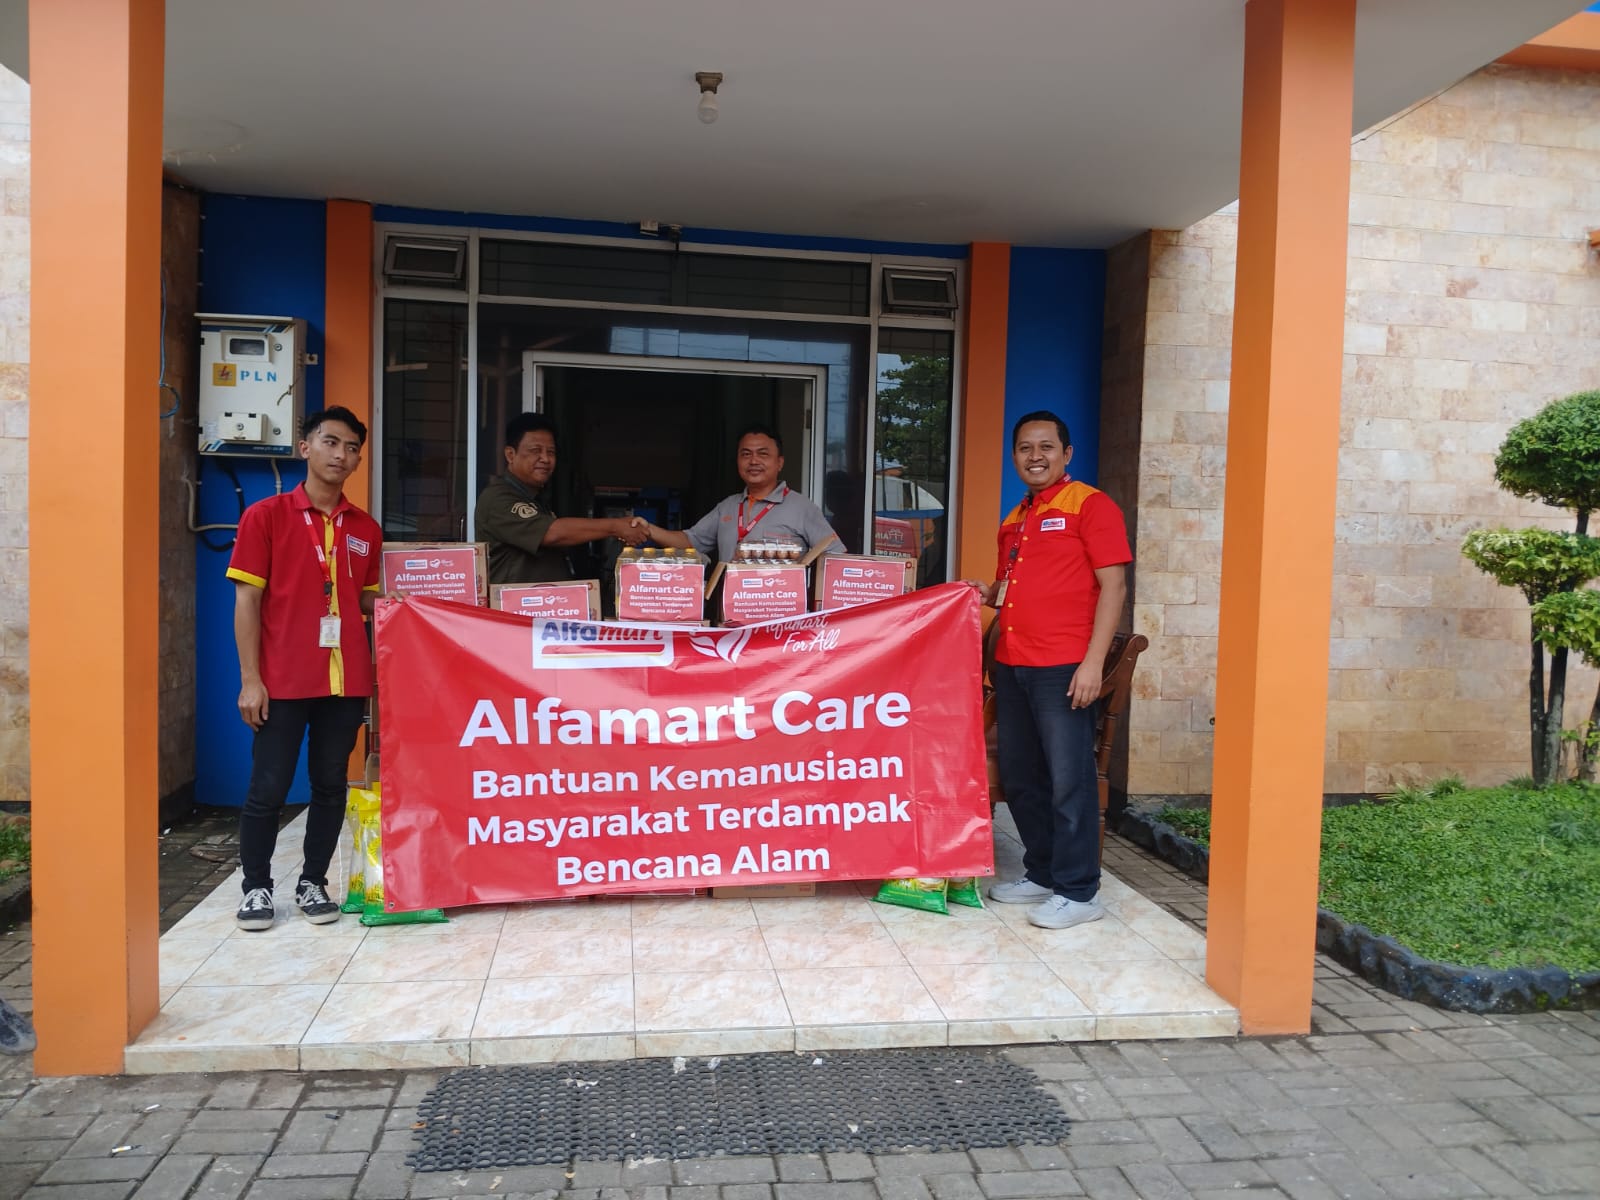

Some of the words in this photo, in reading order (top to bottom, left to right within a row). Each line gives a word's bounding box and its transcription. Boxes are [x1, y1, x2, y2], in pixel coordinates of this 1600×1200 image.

[240, 370, 277, 382] PLN
[394, 573, 440, 582] Alfamart
[442, 572, 466, 580] Care
[629, 585, 670, 594] Alfamart
[673, 586, 694, 594] Care
[832, 580, 872, 589] Alfamart
[874, 582, 895, 590] Care
[733, 591, 774, 599] Alfamart
[557, 608, 580, 616] Care
[782, 632, 808, 653] For
[808, 628, 840, 652] All
[459, 697, 756, 747] Alfamart
[772, 690, 911, 736] Care
[472, 767, 638, 800] Bantuan
[650, 751, 904, 792] Kemanusiaan
[467, 806, 690, 848] Masyarakat
[698, 794, 912, 831] Terdampak
[556, 847, 722, 886] Bencana
[731, 843, 830, 874] Alam
